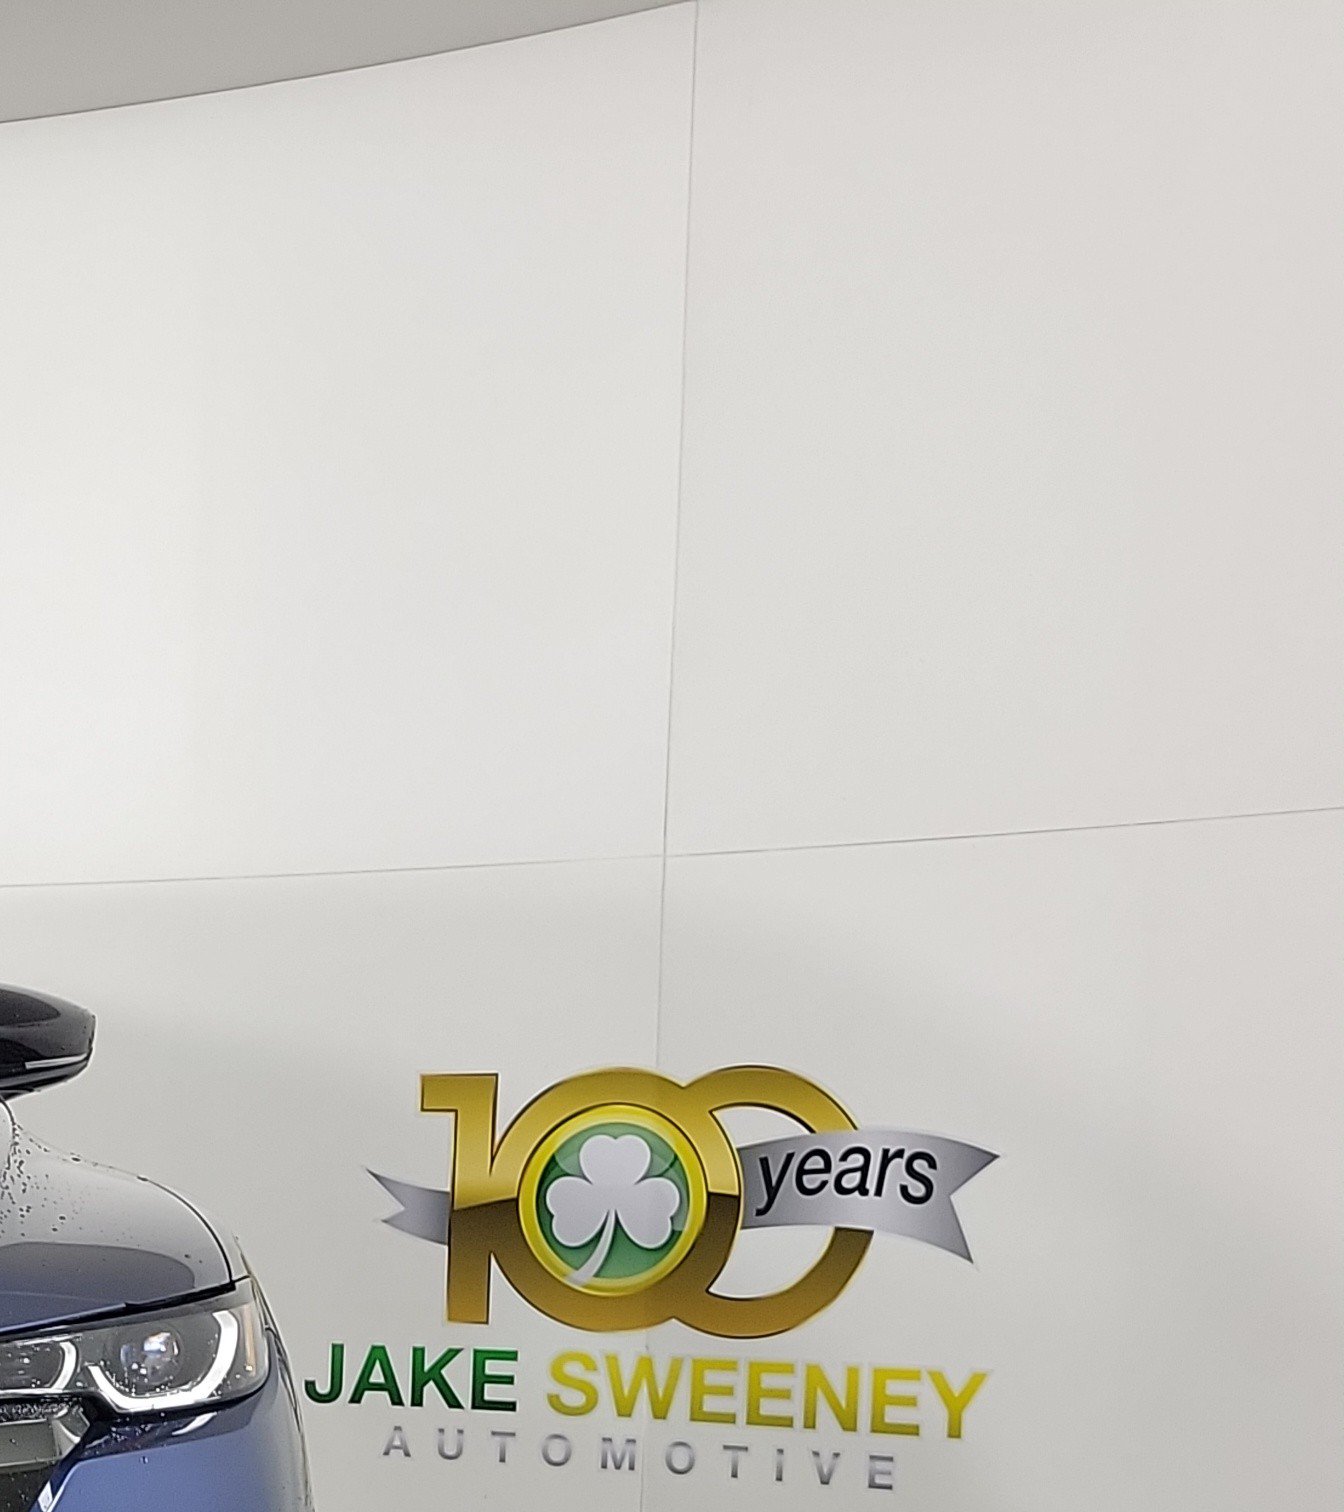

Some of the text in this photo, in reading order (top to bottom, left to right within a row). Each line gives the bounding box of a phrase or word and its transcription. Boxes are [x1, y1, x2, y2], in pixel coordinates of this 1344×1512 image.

[420, 1064, 939, 1340] 100 years
[304, 1343, 990, 1440] JAKE SWEENEY
[382, 1424, 895, 1491] AUTOMOTIVE
